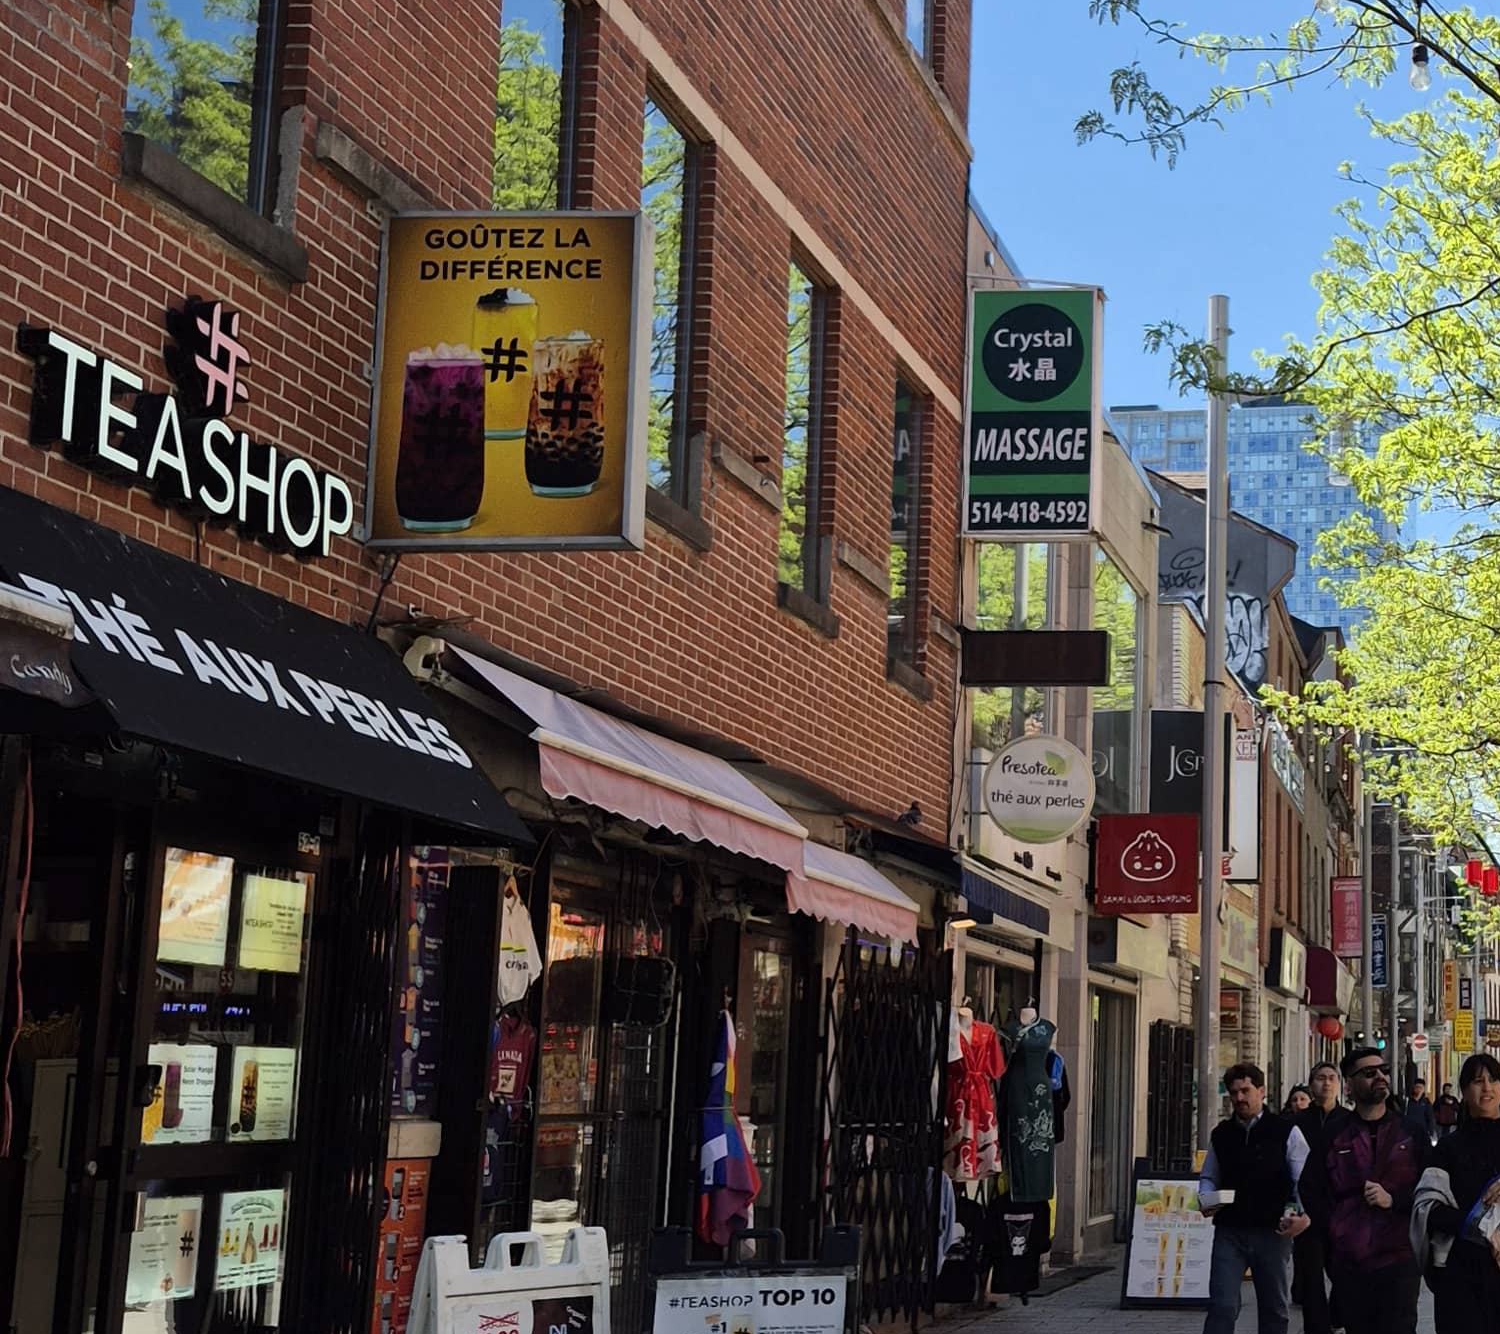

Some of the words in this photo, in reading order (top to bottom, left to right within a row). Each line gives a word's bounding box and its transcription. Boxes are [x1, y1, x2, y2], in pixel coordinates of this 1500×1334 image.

[424, 223, 545, 251] GOÛTEZ
[554, 227, 592, 250] LA
[420, 253, 603, 282] DIFFÉRENCE
[992, 325, 1074, 352] Crystal
[1007, 357, 1057, 384] 水晶
[48, 331, 354, 557] TEASHOP
[973, 425, 1087, 463] MASSAGE
[970, 499, 1088, 525] 514-418-4592
[10, 653, 73, 696] Candy
[18, 572, 184, 676] THÉ
[174, 627, 305, 717] AUX
[294, 671, 472, 768] PERLES
[1001, 754, 1057, 776] Presotea
[991, 790, 1013, 805] thé
[1016, 793, 1041, 806] aux
[1045, 794, 1085, 810] perles
[758, 1288, 805, 1307] TOP
[811, 1288, 836, 1306] 10
[711, 1321, 727, 1334] #1
